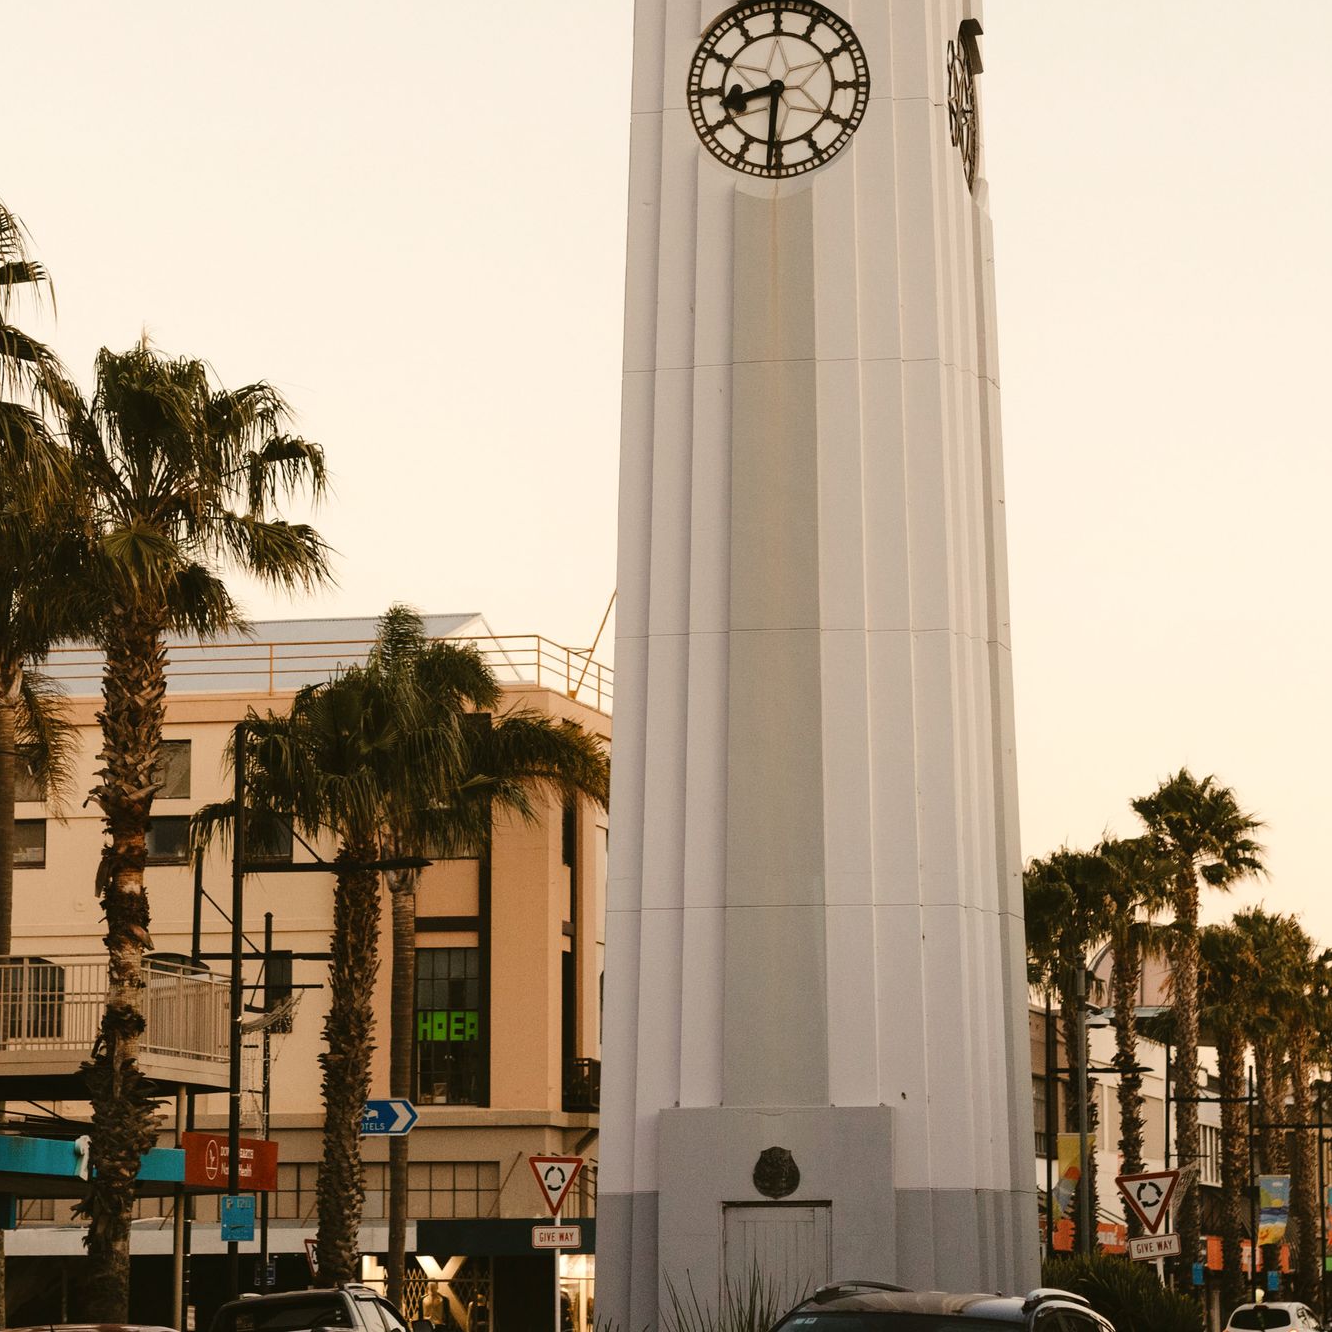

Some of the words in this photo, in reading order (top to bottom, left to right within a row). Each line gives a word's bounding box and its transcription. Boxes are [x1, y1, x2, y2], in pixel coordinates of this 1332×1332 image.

[360, 1122, 386, 1131] OTELS
[539, 1232, 556, 1243] GIVE
[559, 1232, 575, 1242] WAY
[1136, 1243, 1155, 1255] GIVE
[1156, 1240, 1174, 1252] WAY
